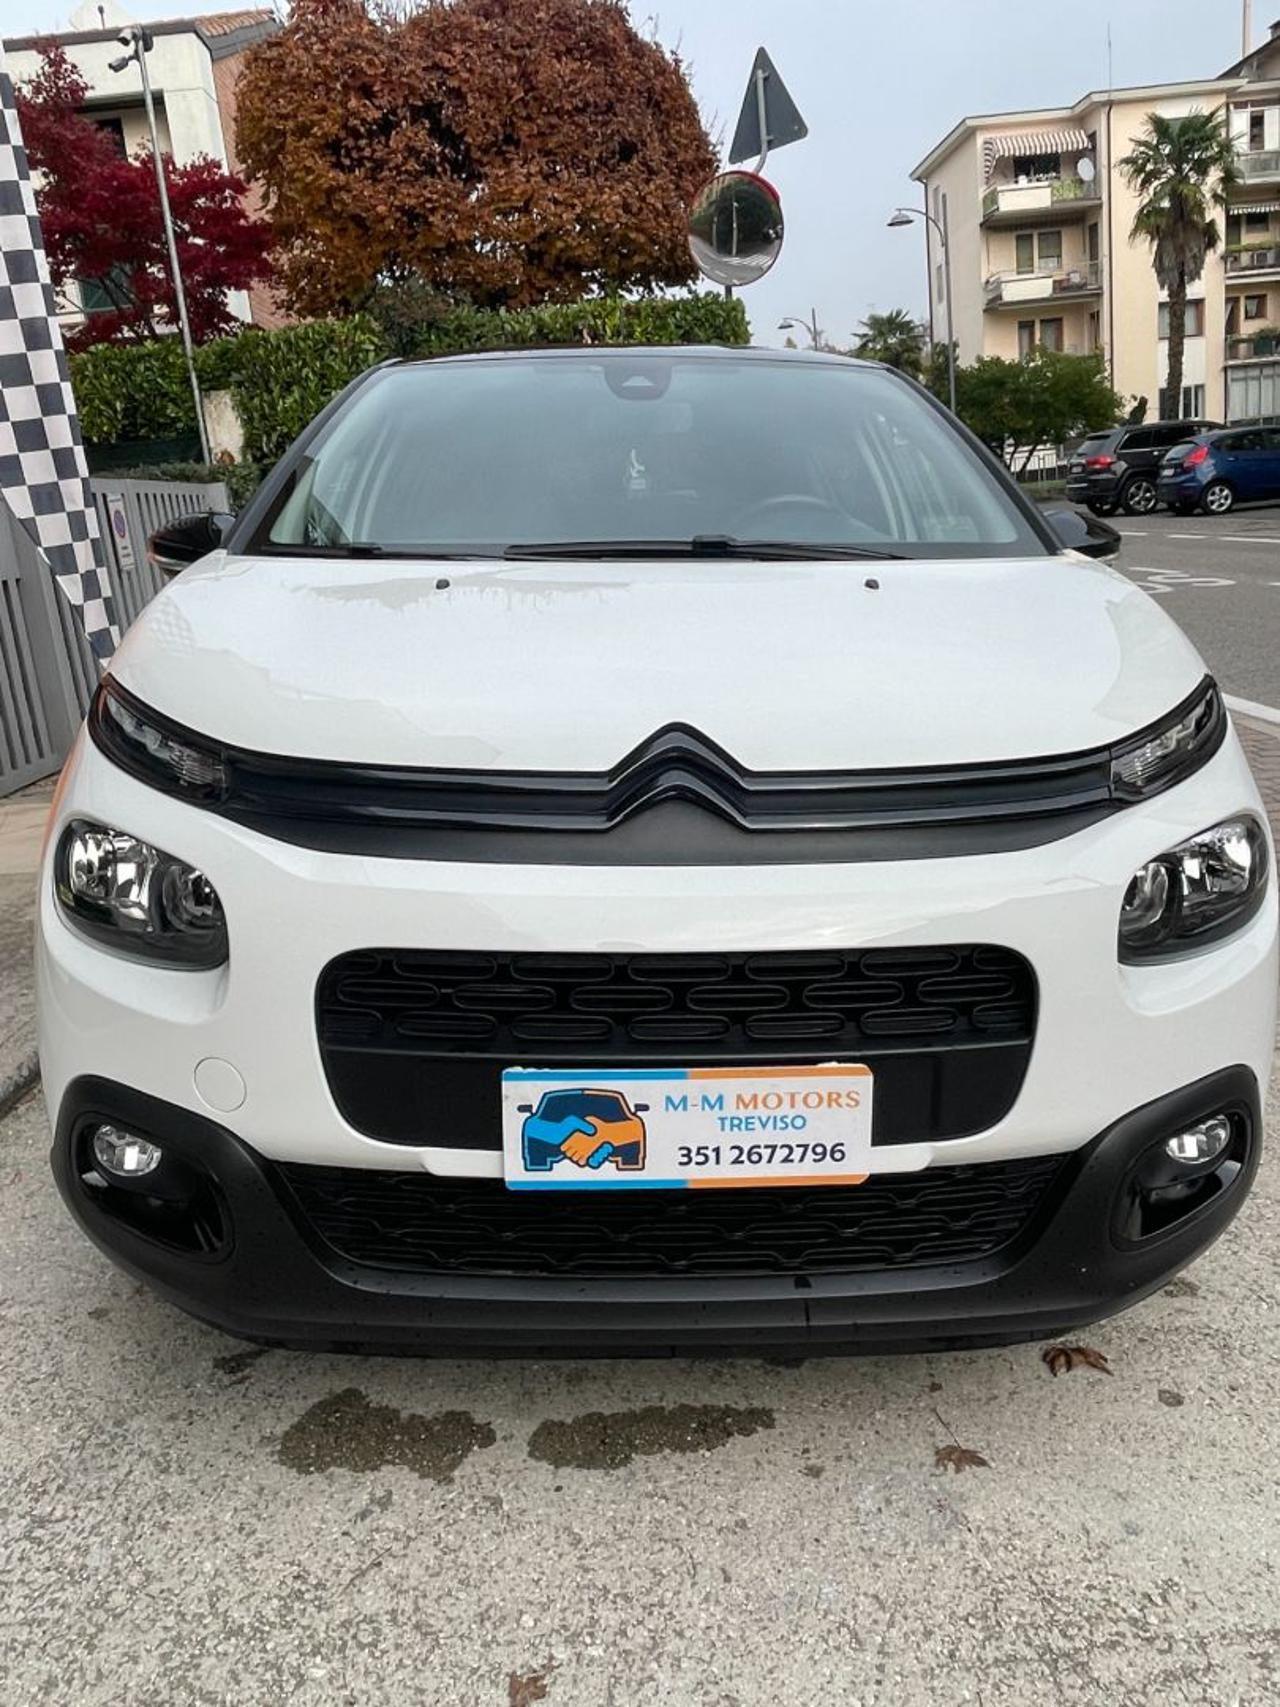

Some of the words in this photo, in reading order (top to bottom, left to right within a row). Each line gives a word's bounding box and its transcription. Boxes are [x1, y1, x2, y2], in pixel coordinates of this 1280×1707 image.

[665, 1094, 724, 1112] M-M
[735, 1091, 861, 1110] MOTORS
[717, 1115, 807, 1132] TREVISO
[678, 1144, 721, 1166] 351
[731, 1142, 846, 1164] 2672796
